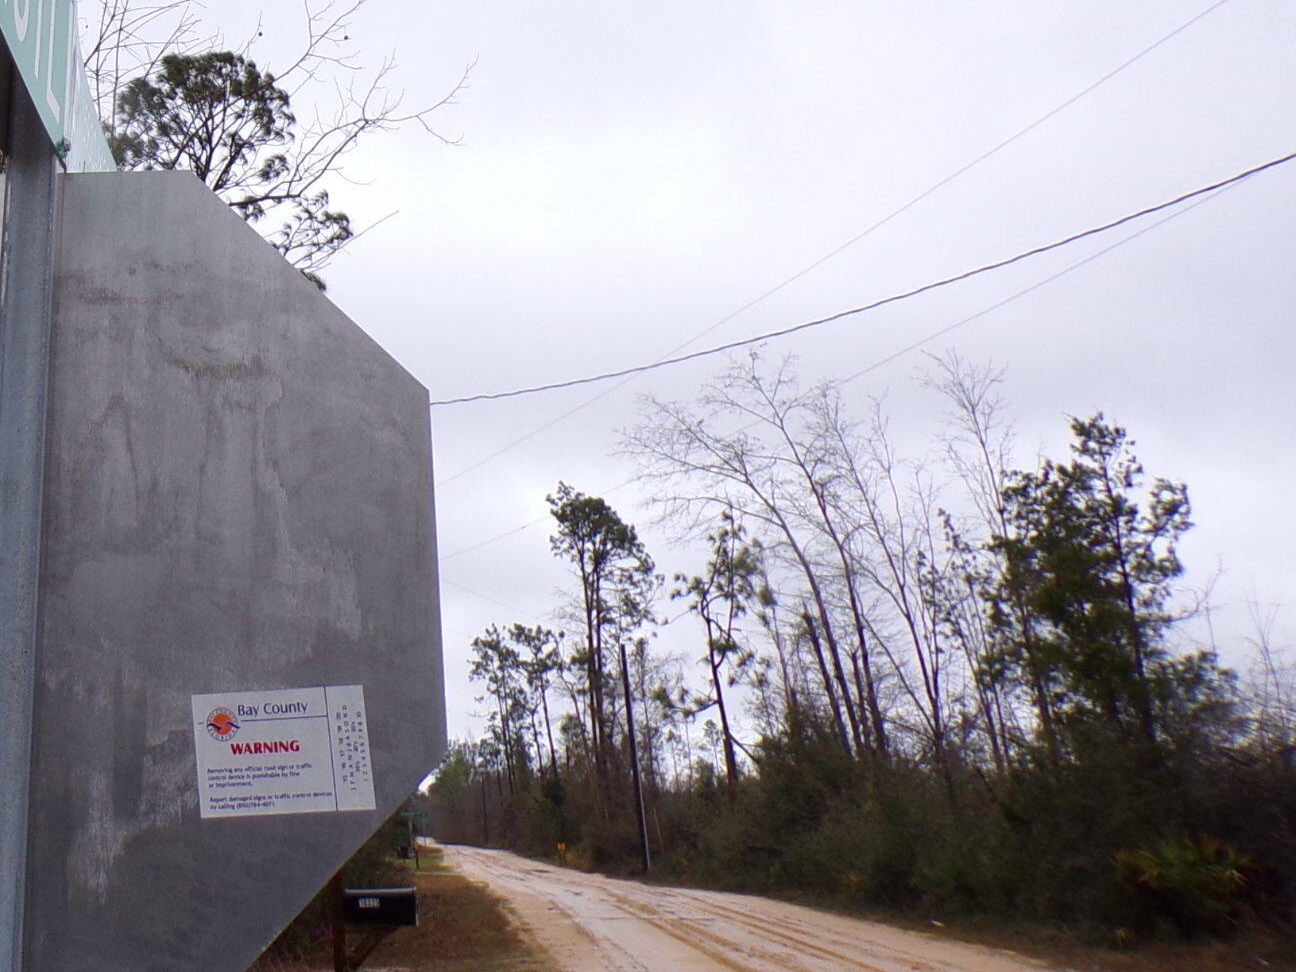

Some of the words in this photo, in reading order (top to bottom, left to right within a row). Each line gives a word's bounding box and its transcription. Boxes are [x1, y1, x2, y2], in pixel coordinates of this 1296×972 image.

[237, 704, 260, 717] Bay
[263, 701, 308, 715] County
[230, 739, 300, 755] WARNING
